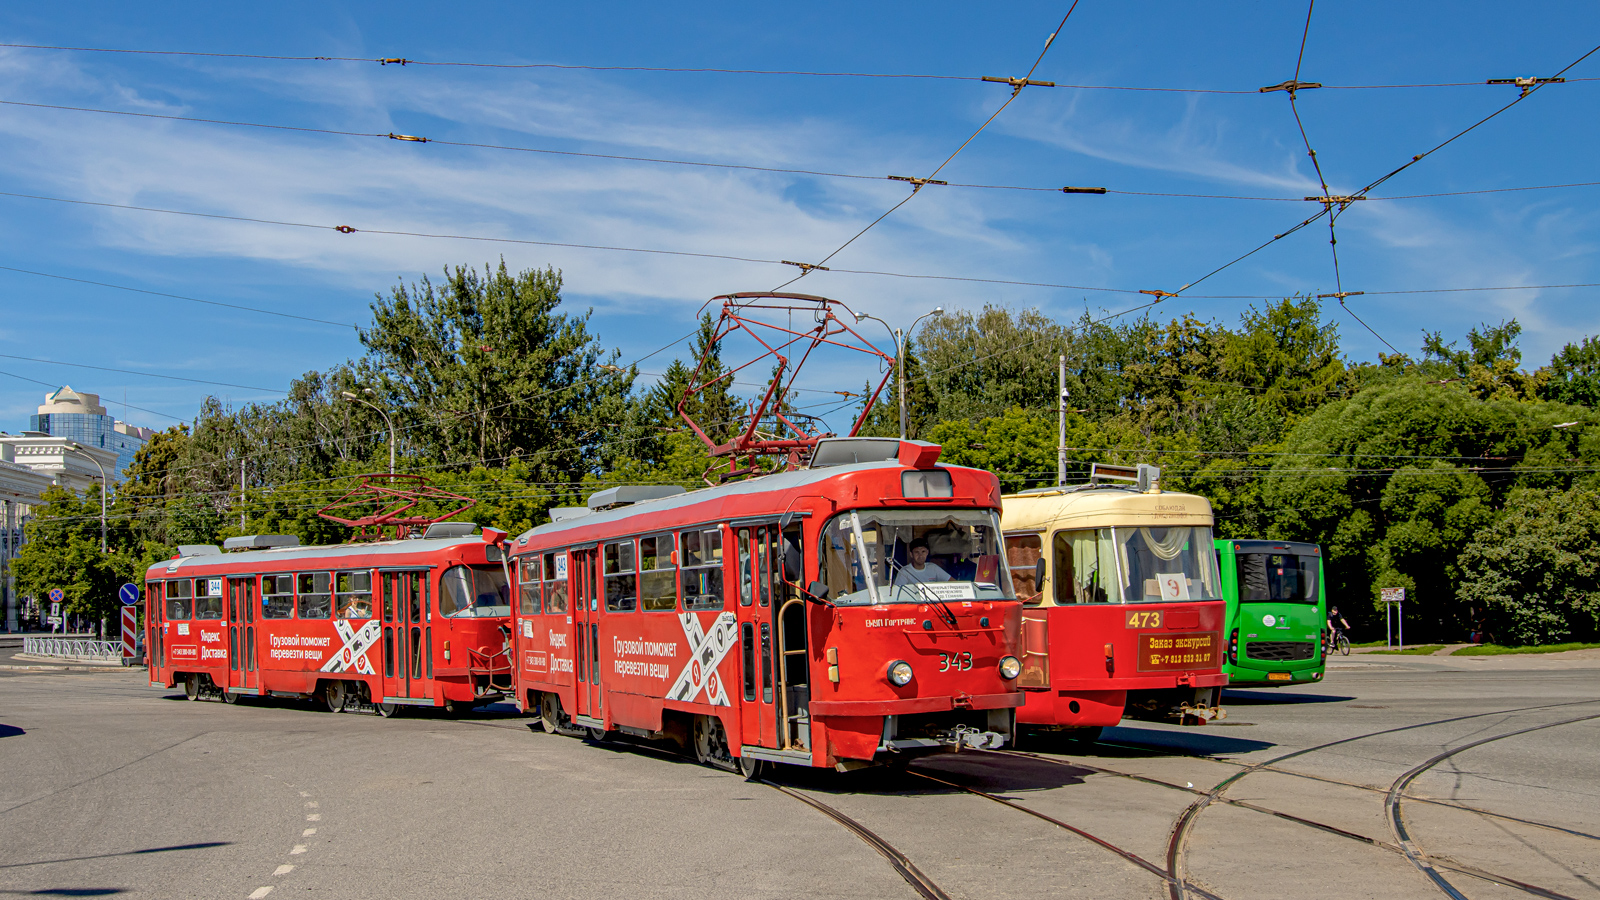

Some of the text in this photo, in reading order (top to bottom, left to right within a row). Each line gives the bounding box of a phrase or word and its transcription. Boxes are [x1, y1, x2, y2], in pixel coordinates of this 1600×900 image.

[1272, 555, 1282, 565] 54
[210, 581, 220, 591] 344
[1128, 612, 1160, 628] 473
[200, 629, 220, 643] Яндекс
[269, 634, 330, 648] Грузовой поможет
[549, 629, 567, 649] Яндекс
[1149, 635, 1211, 649] Заказ экскурсий
[201, 646, 228, 660] Доставка
[613, 635, 677, 657] Грузовой поможет
[270, 648, 323, 661] перевезти вещи
[1160, 655, 1170, 664] +7
[550, 653, 574, 674] Доставка
[939, 652, 973, 672] 343
[614, 660, 669, 682] перевезти вещи
